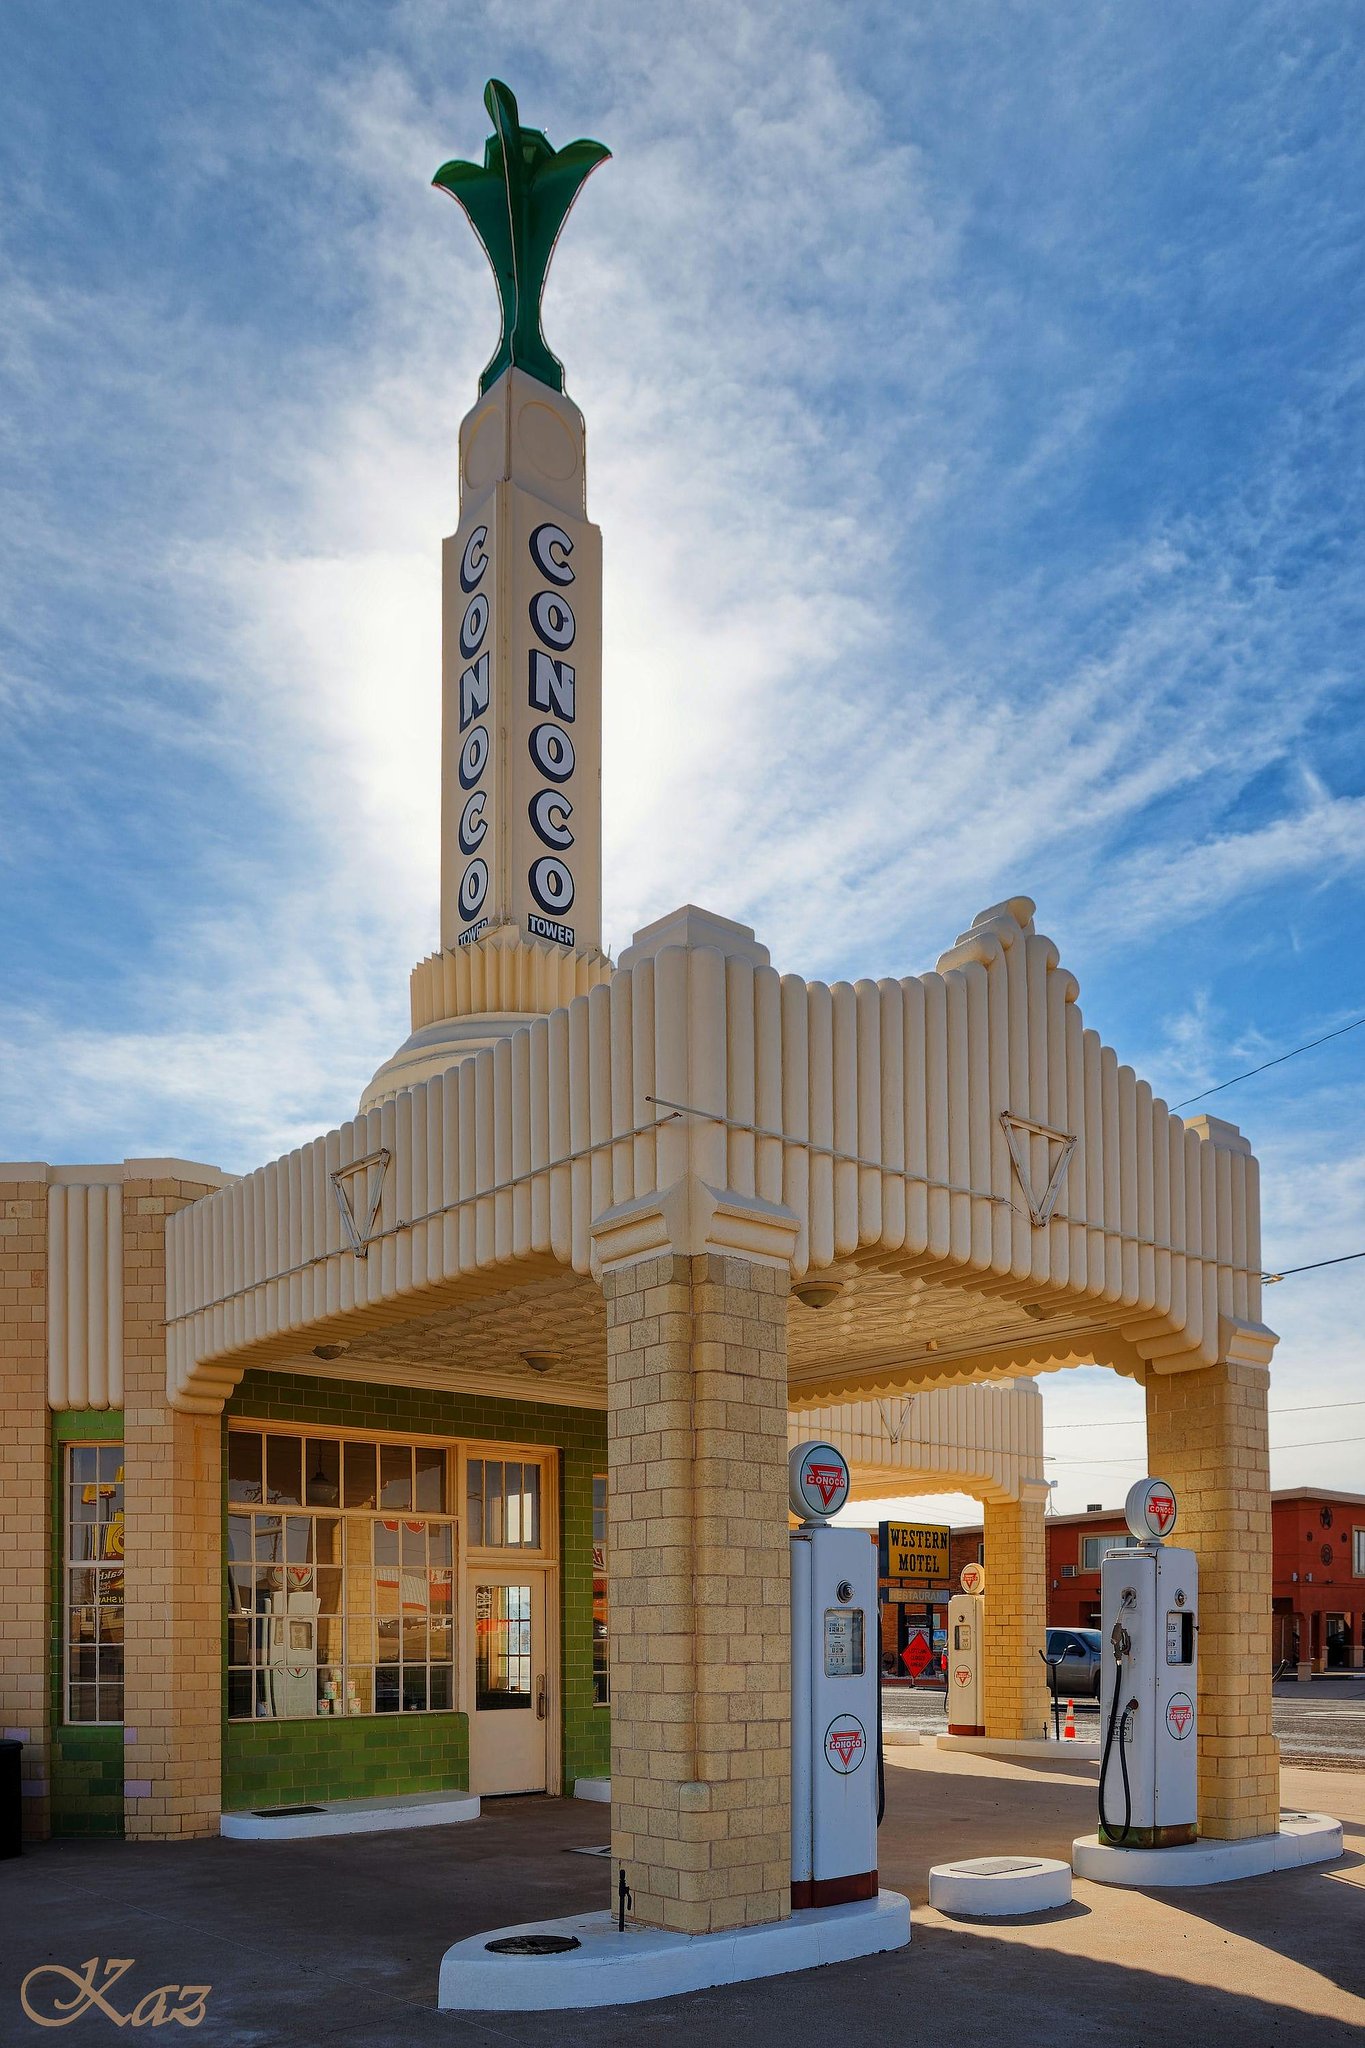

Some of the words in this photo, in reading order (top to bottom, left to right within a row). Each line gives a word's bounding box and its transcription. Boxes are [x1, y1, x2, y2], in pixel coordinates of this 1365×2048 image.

[458, 525, 489, 921] CONOCO
[528, 522, 576, 915] CONOCO
[529, 915, 574, 945] TOWER
[808, 1475, 845, 1487] CONOCO
[890, 1528, 948, 1549] WESTERN
[898, 1553, 940, 1573] MOTEL
[1170, 1712, 1191, 1721] CONOCO
[831, 1740, 861, 1749] CONOCO
